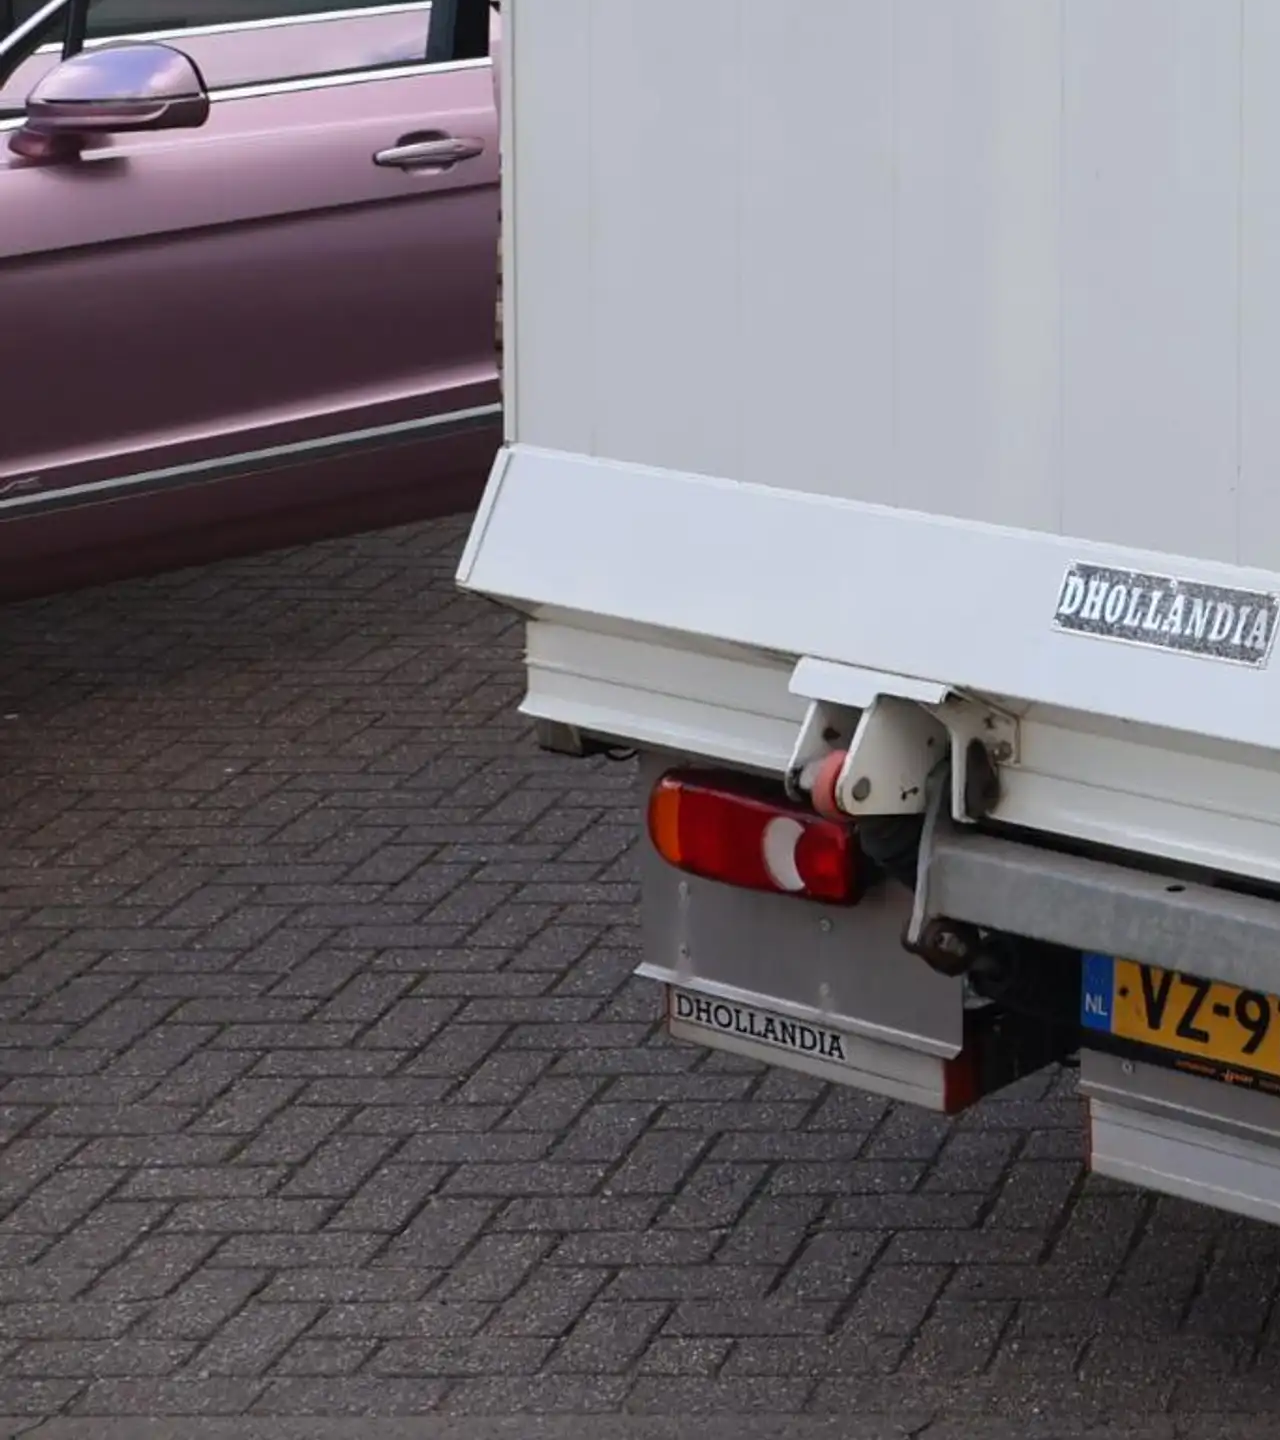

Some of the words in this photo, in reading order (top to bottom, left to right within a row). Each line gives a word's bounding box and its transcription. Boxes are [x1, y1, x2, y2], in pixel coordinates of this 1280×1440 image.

[1058, 576, 1269, 650] DHOLLANDIA
[675, 993, 845, 1059] DHOLLANDIA
[1084, 992, 1108, 1016] NL
